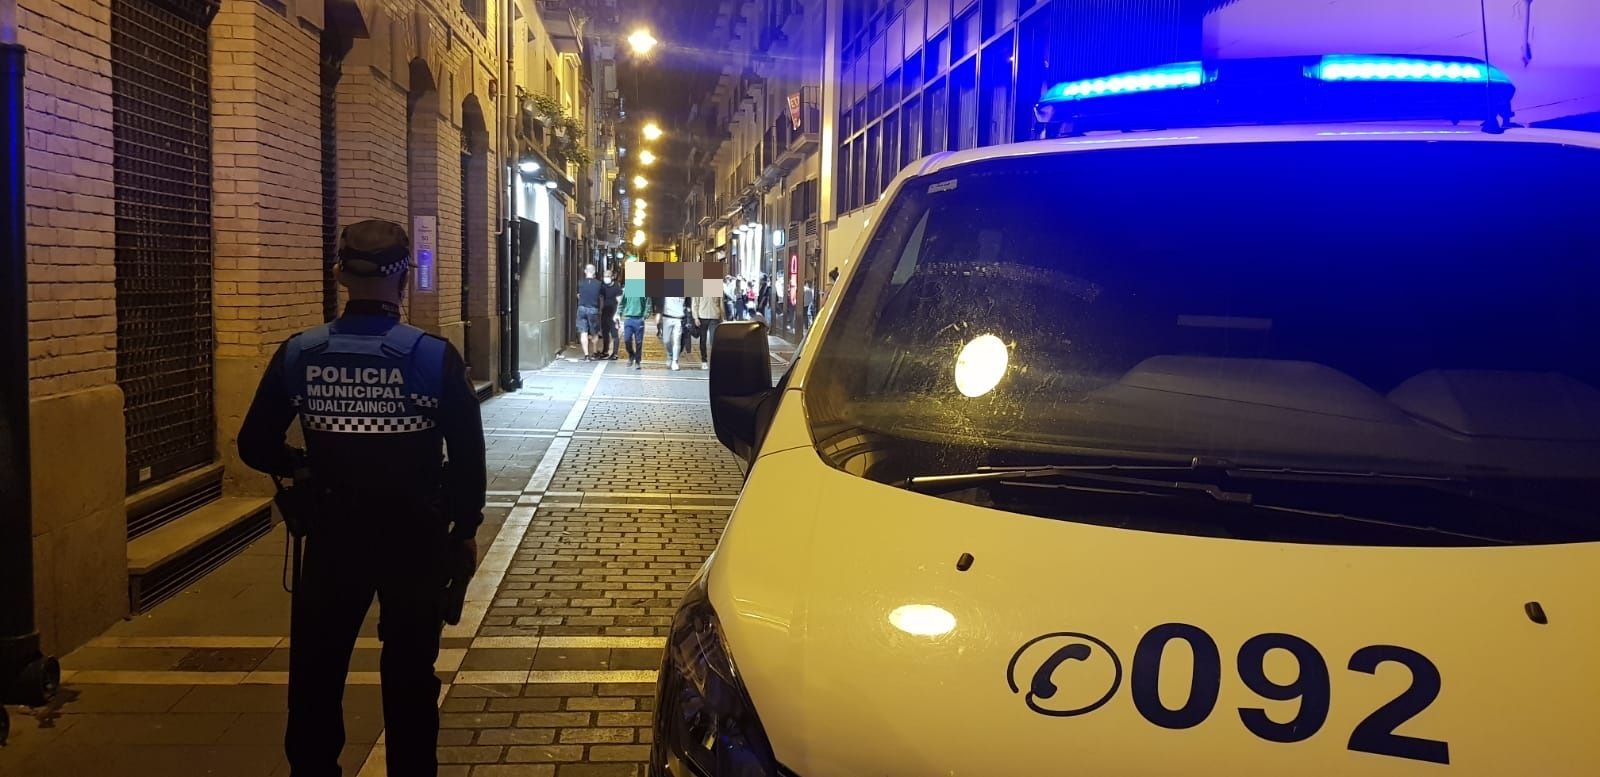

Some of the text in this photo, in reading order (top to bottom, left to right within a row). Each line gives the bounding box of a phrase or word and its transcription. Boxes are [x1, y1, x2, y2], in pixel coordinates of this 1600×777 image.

[306, 365, 404, 385] POLICIA
[307, 385, 405, 399] MUNICIPAL
[1130, 622, 1450, 765] 092
